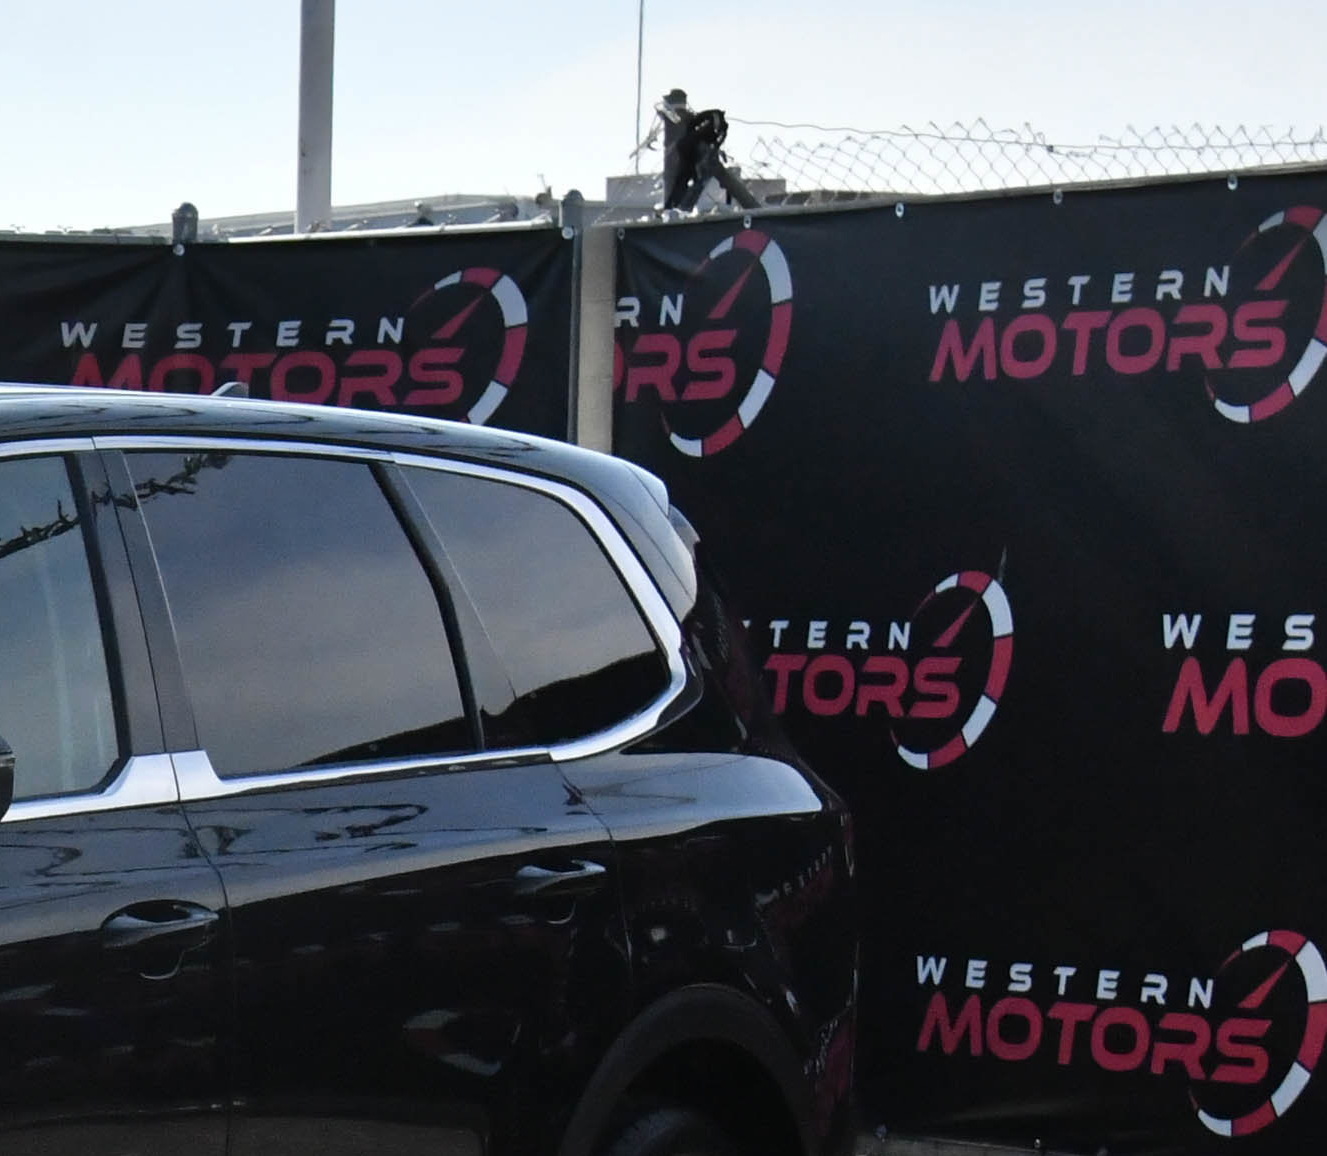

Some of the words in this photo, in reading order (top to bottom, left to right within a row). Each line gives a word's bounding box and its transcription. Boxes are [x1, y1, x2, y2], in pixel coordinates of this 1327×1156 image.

[929, 265, 1230, 314] WESTERN
[60, 317, 404, 349] WESTERN
[929, 300, 1288, 383] MOTORS
[70, 347, 465, 407] MOTORS
[613, 329, 737, 402] RS
[742, 619, 912, 651] TERN
[1162, 613, 1315, 651] WES
[764, 653, 963, 719] TORS
[1162, 656, 1327, 738] MO
[917, 956, 1214, 1009] WESTERN
[917, 990, 1272, 1084] MOTORS
